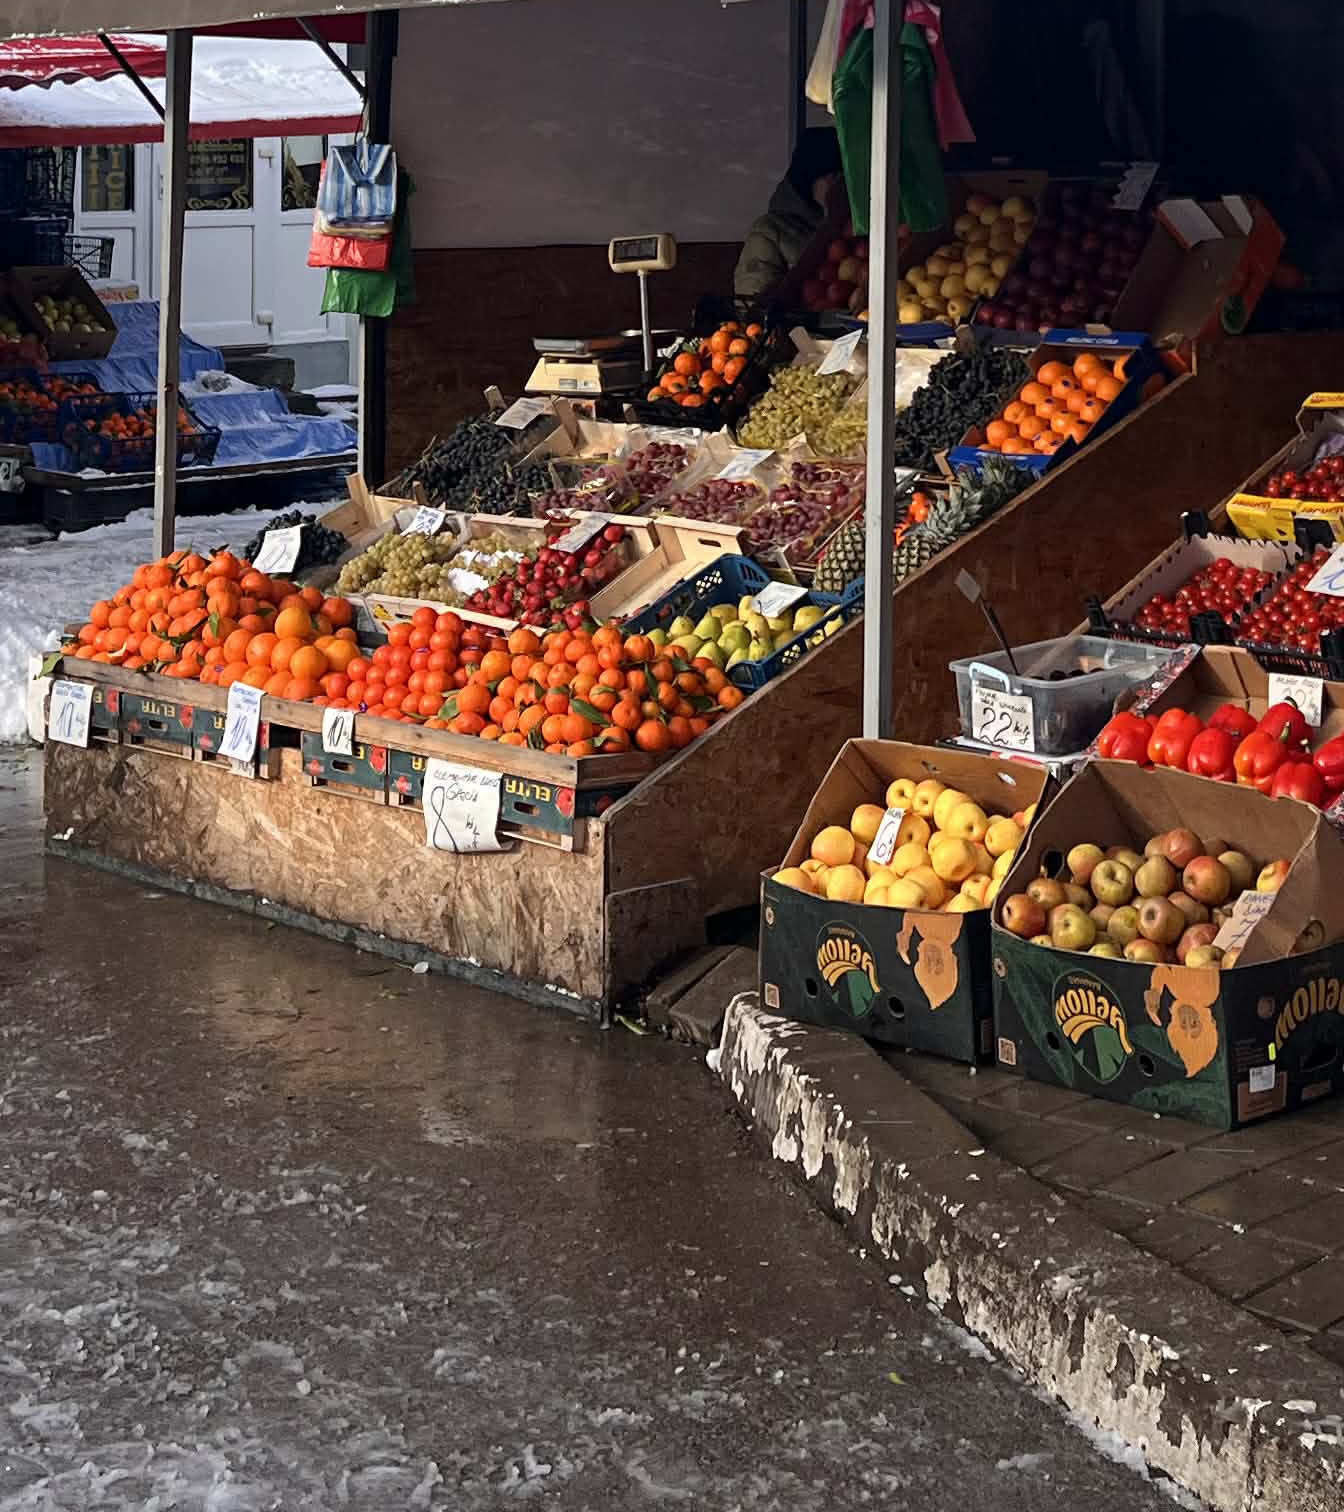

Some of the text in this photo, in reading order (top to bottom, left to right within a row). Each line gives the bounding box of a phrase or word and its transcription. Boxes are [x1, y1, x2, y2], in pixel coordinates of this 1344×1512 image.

[328, 715, 345, 747] 10
[979, 706, 1013, 745] 22
[430, 785, 459, 853] 8
[876, 820, 896, 858] 6
